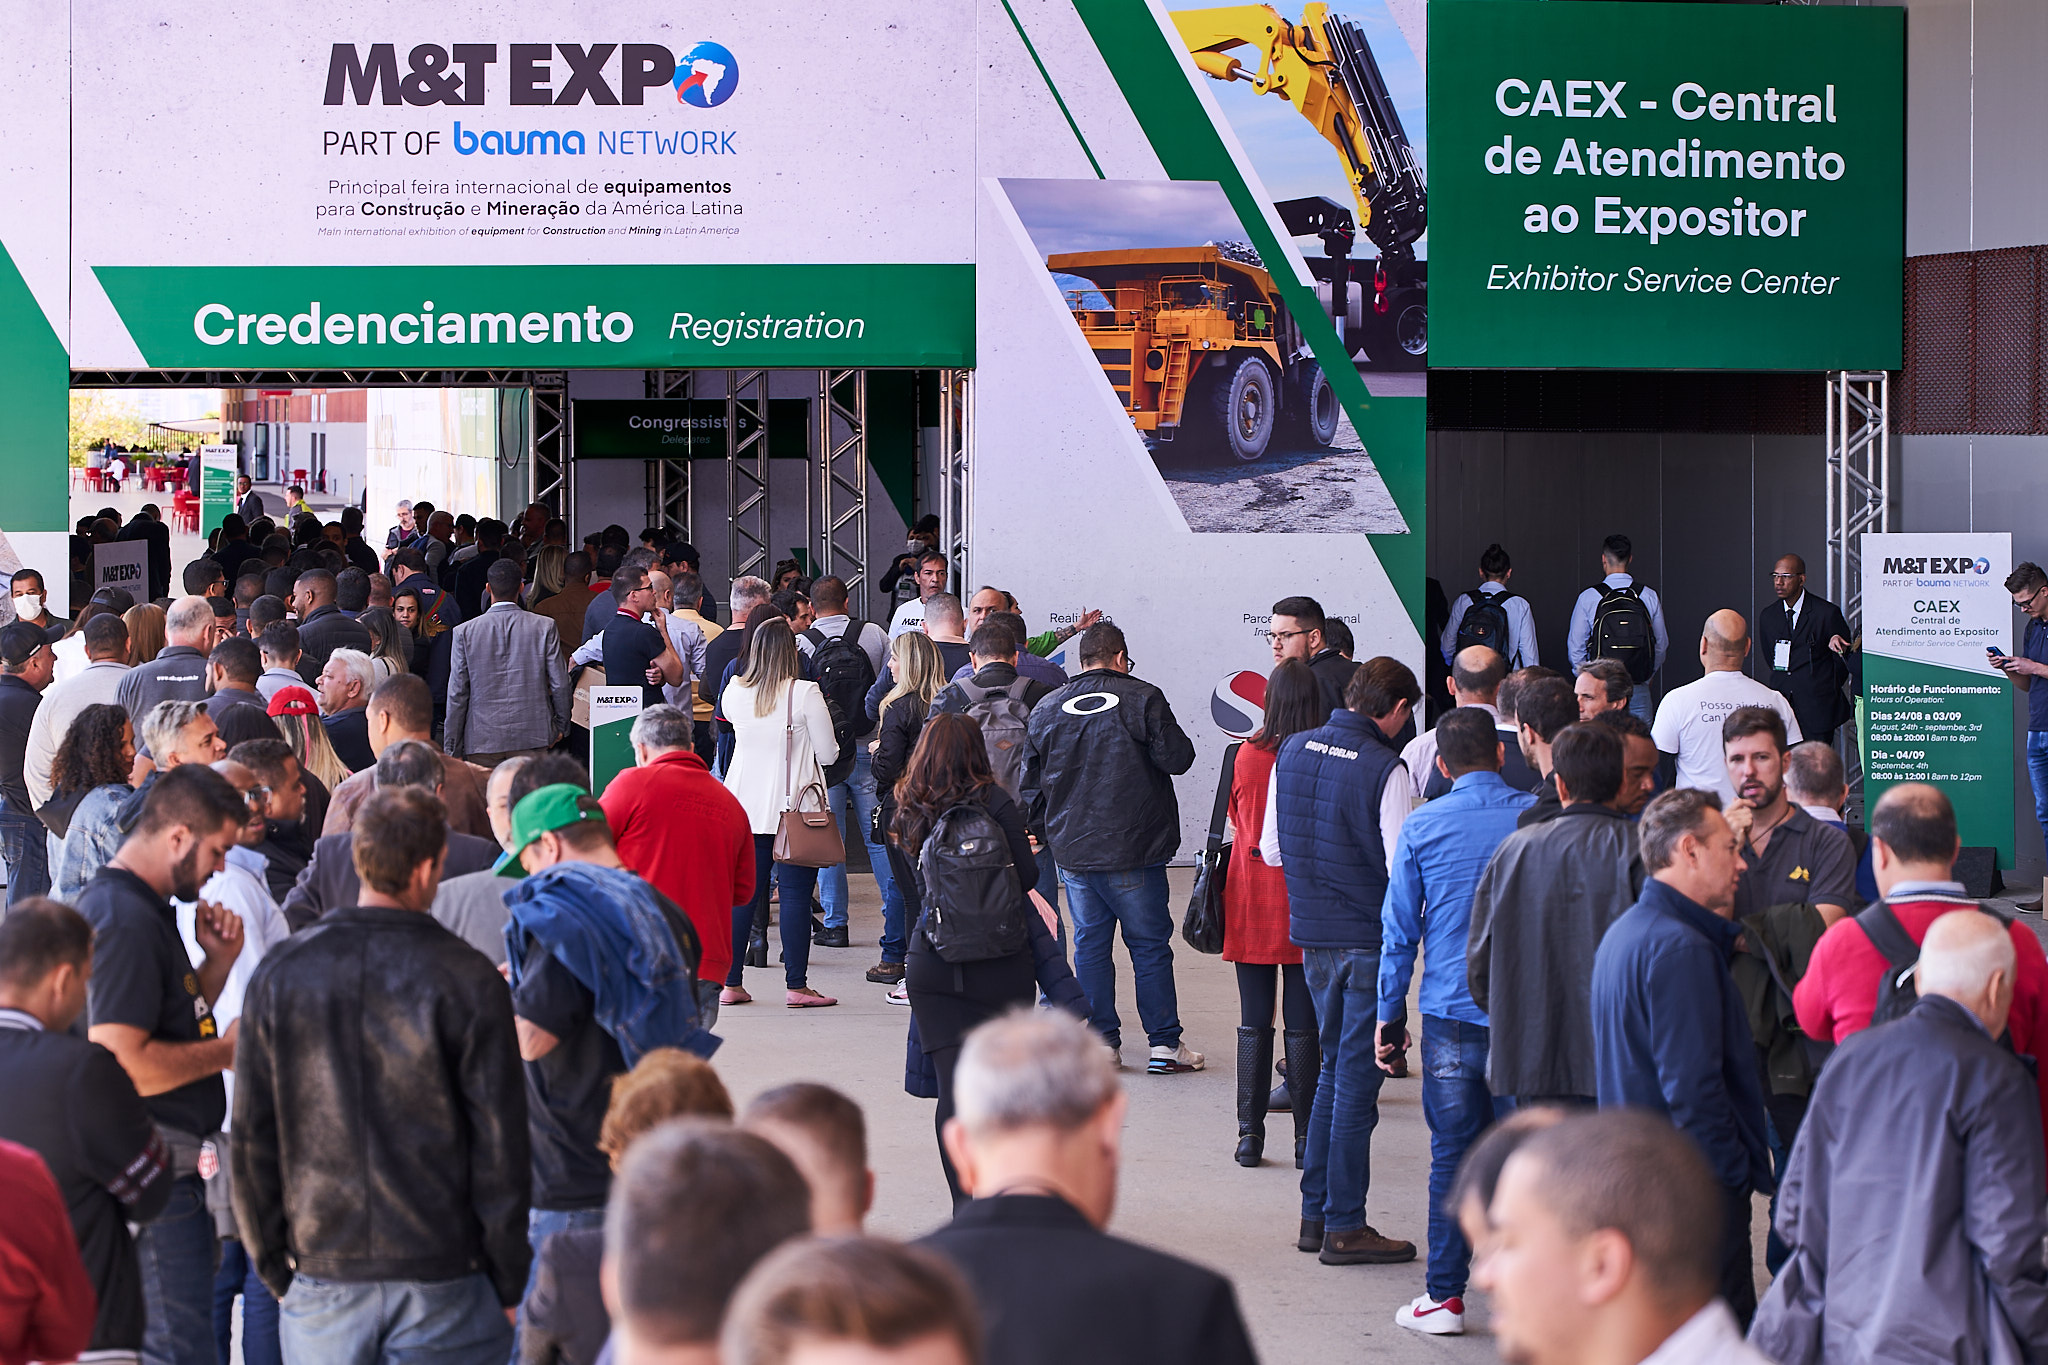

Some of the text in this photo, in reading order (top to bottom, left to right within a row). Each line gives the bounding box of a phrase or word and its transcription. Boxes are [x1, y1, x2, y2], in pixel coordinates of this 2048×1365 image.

[323, 43, 497, 107] M&T
[1495, 78, 1837, 123] CAEX - Central
[323, 121, 738, 155] PART OF bauma NETWORK
[1484, 134, 1846, 181] de Atendimento
[329, 179, 732, 197] Principal feira internacional de equipamentos
[316, 200, 743, 220] para Construção e Mineração da América Latina
[1523, 196, 1807, 245] ao Expositor
[318, 228, 341, 236] Main
[344, 228, 406, 236] international
[408, 227, 456, 236] exhibition
[459, 227, 469, 236] of
[471, 227, 525, 237] equipment
[527, 227, 539, 236] for
[543, 226, 606, 236] Construction
[608, 227, 626, 236] and
[629, 226, 662, 237] Mining
[674, 227, 697, 235] Latin
[699, 227, 740, 235] America
[1486, 263, 1841, 295] Exhibitor Service Center
[193, 301, 635, 346] Credenciamento
[668, 311, 866, 347] Registration
[629, 415, 747, 432] Congressists
[1883, 557, 1927, 574] M&T
[102, 566, 119, 583] M&T
[1916, 578, 1951, 587] bauma
[1913, 600, 1961, 613] CAEX
[1910, 616, 1960, 624] Central de
[1875, 627, 1937, 636] Atendimento
[1954, 627, 1999, 637] Expositor
[1870, 684, 2001, 694] Horário de Funcionamento:
[1700, 701, 1733, 710] Posso
[1904, 696, 1944, 704] Operation:
[1701, 713, 1720, 722] Can
[1870, 711, 1892, 720] Dias
[1894, 711, 1923, 721] 24/08
[1933, 712, 1962, 721] 03/09
[1870, 723, 1899, 732] August,
[1901, 723, 1919, 731] 24th
[1925, 723, 1967, 732] september,
[1968, 723, 1983, 731] 3rd
[1870, 733, 1892, 741] 08:00
[1904, 733, 1926, 741] 20:00
[1959, 734, 1977, 743] 8pm
[1305, 740, 1359, 760] GRUPO COELHO
[1871, 750, 1888, 759] Dia
[1896, 750, 1925, 760] 04/09
[1871, 761, 1929, 770] September, 4th
[1871, 772, 1893, 780] 08:00
[1905, 772, 1926, 780] 12:00
[1959, 773, 1982, 782] 12pm
